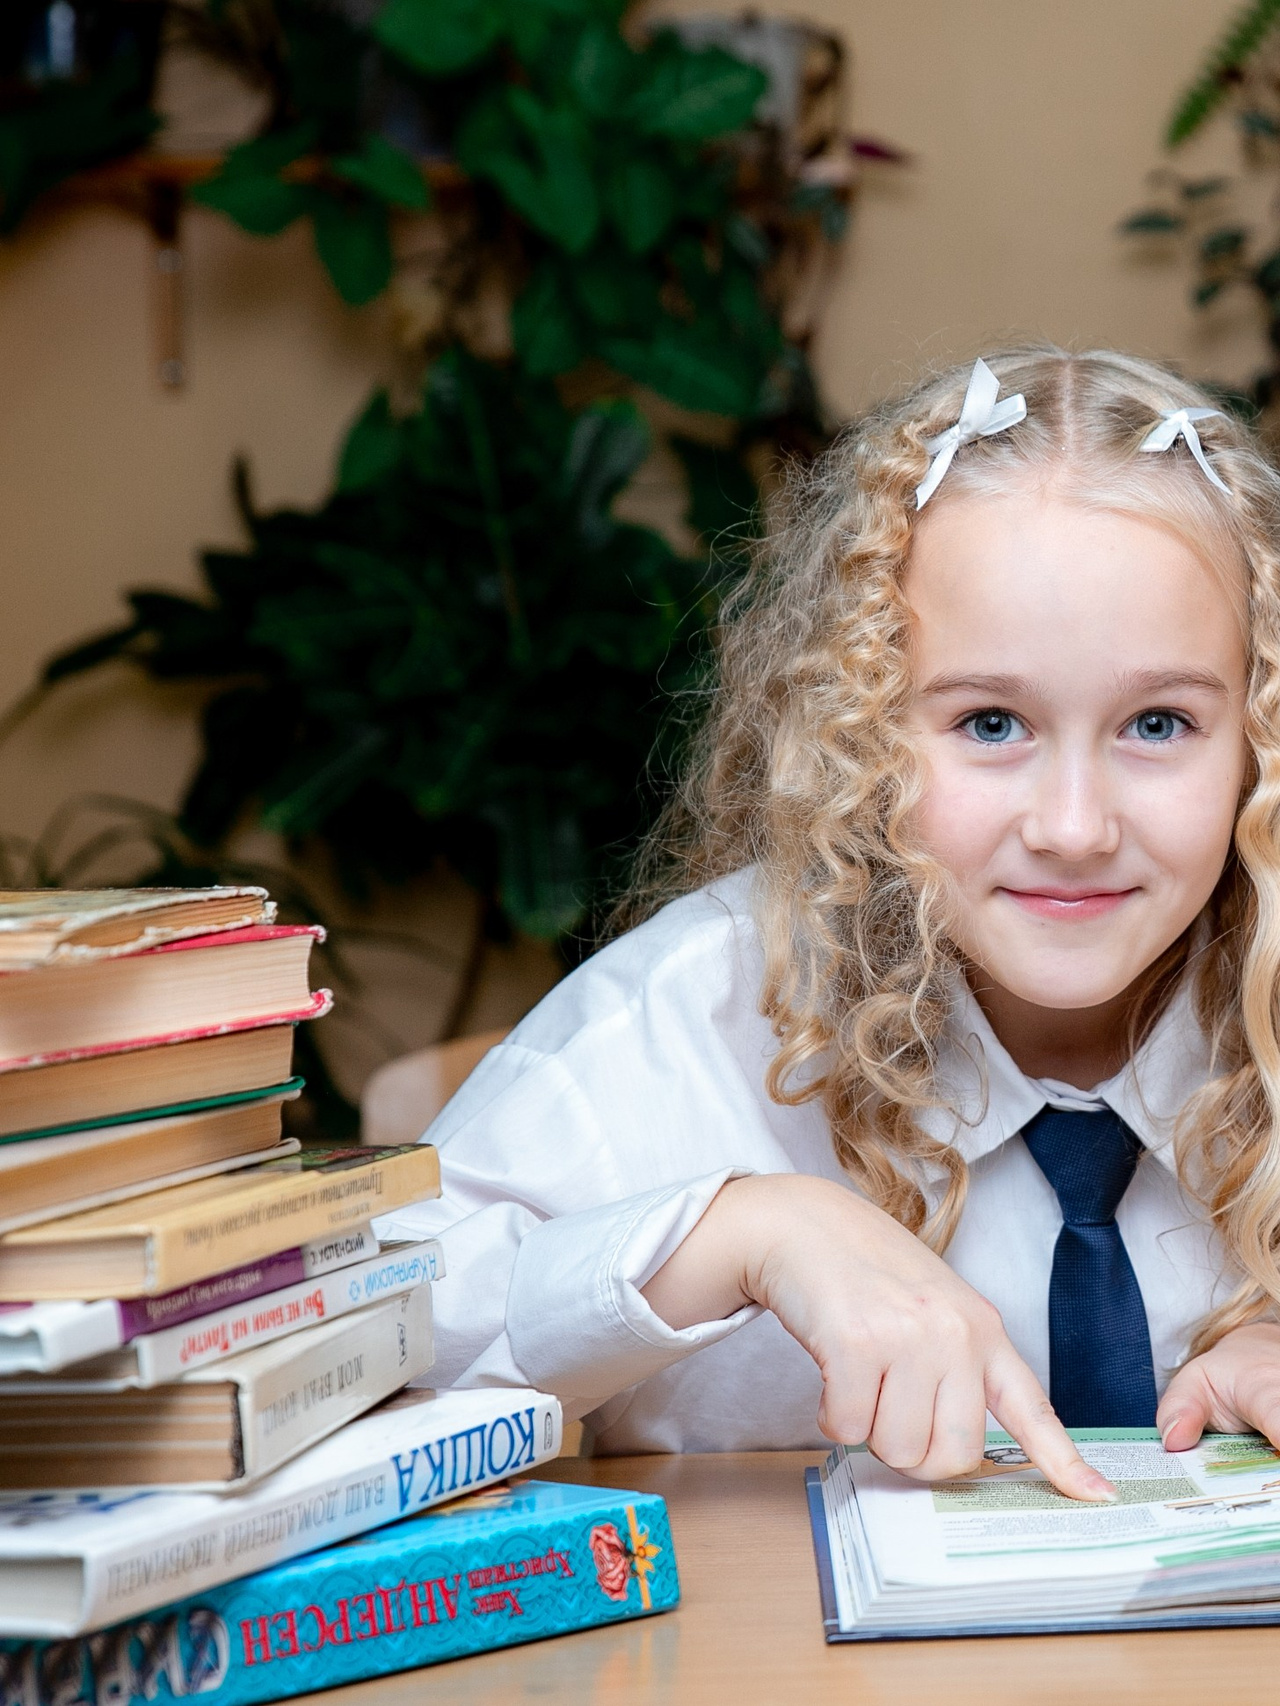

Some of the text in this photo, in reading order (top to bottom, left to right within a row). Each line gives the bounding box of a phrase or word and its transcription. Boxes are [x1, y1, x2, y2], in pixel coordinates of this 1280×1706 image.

[319, 1167, 384, 1205] Путешествие
[216, 1202, 261, 1235] русского
[265, 1192, 309, 1221] историю
[319, 1232, 365, 1264] УСПЕНСКИЙ
[303, 1371, 333, 1410] БРАТ
[391, 1407, 536, 1512] КОШКА
[344, 1474, 387, 1516] ВАШ
[223, 1488, 339, 1567] ДОМАШНИЙ
[106, 1528, 217, 1601] ЛЮБИМЕЦ
[468, 1547, 575, 1589] Христиан
[239, 1574, 462, 1667] АНДЕРСЕН
[472, 1588, 524, 1617] Ханс
